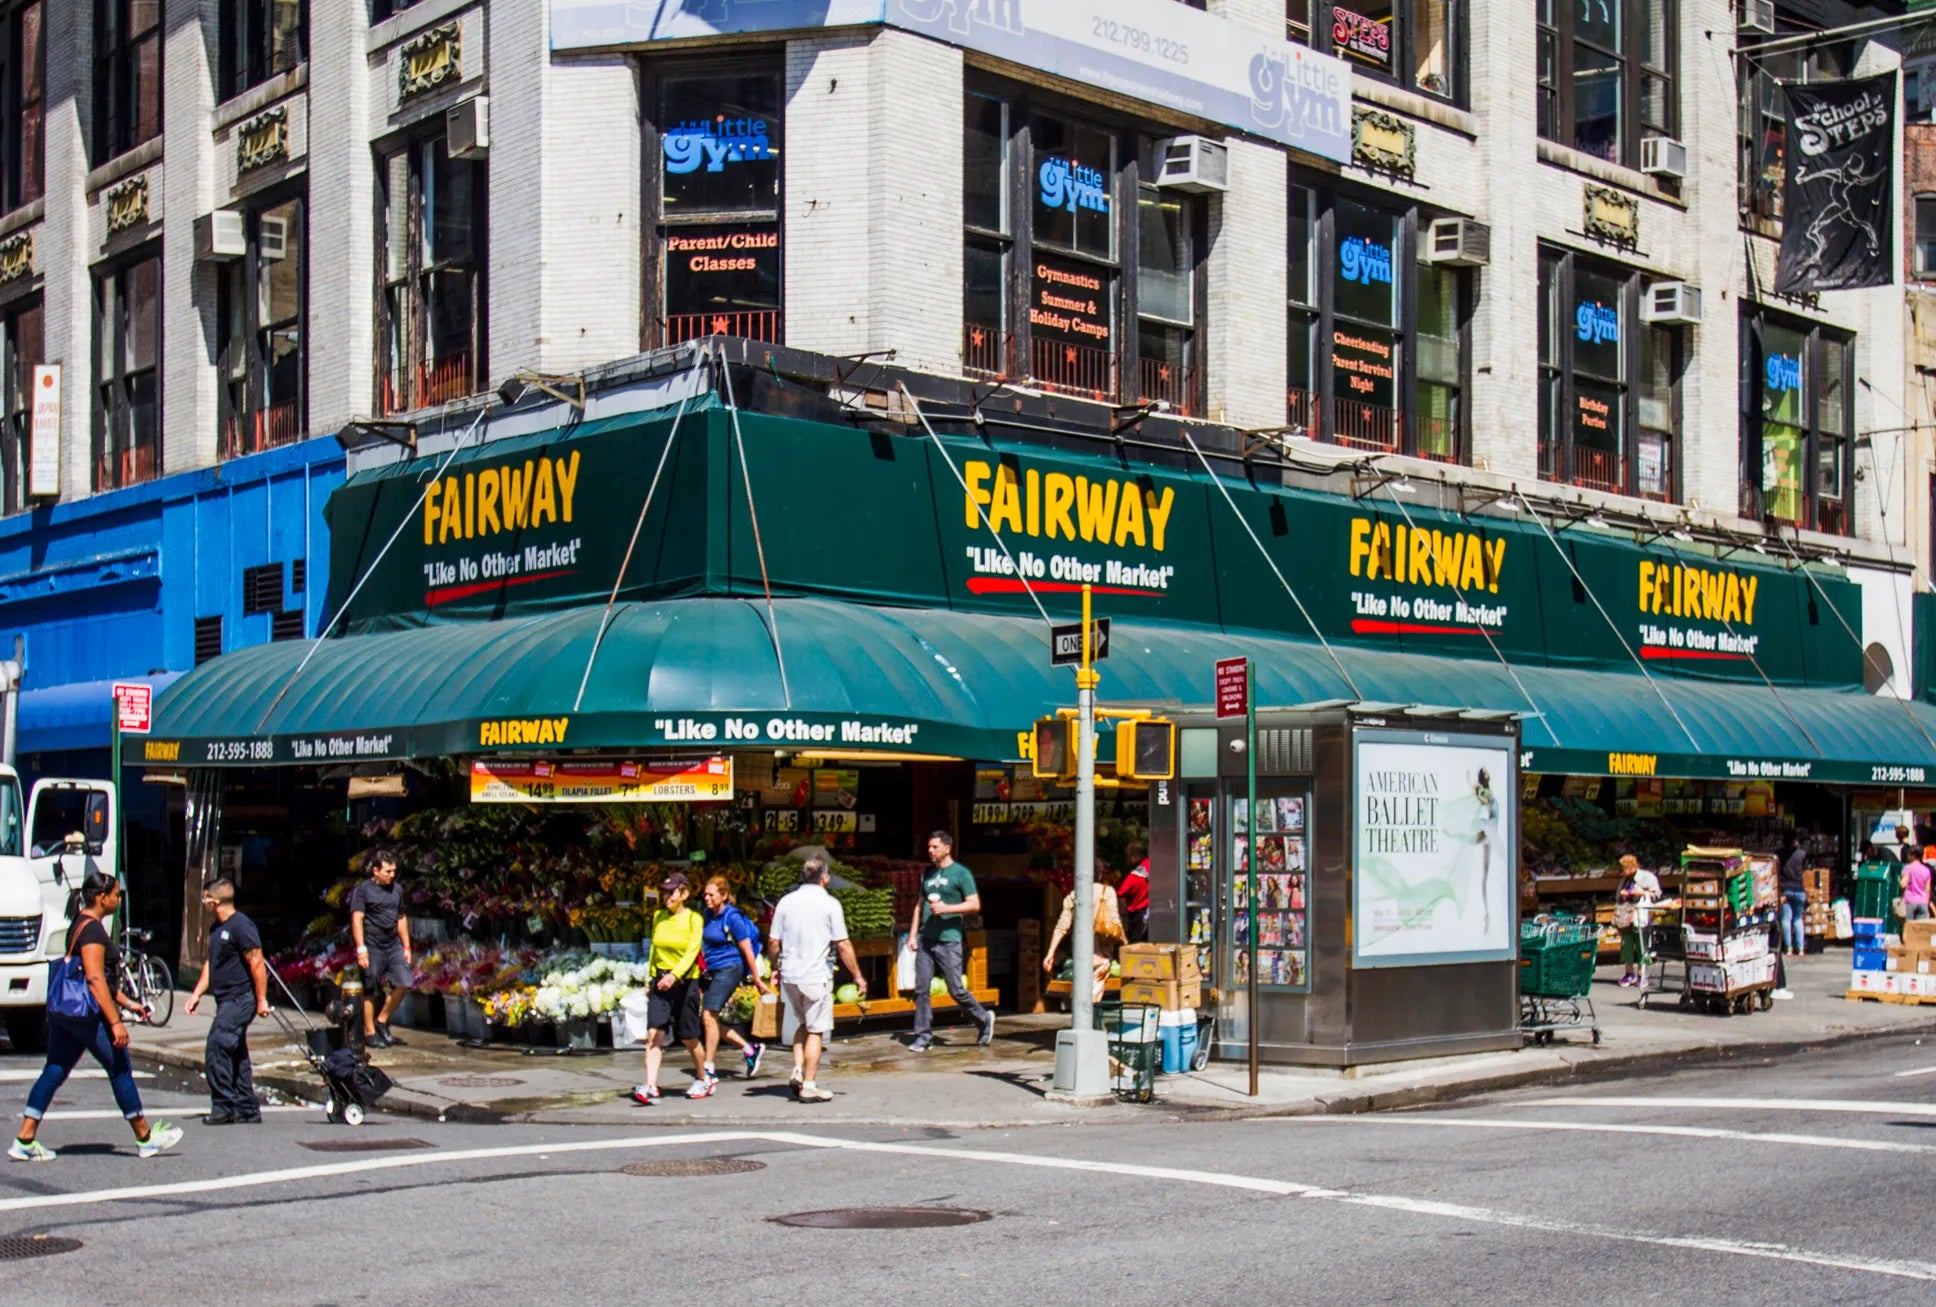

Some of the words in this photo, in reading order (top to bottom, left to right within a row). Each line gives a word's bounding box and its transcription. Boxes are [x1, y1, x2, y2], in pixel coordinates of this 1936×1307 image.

[1092, 16, 1188, 64] 212.799.1225
[1333, 6, 1389, 50] STEPS
[1286, 51, 1338, 95] Little
[1249, 53, 1343, 138] gym
[703, 115, 767, 138] Little
[663, 127, 770, 174] gym
[1066, 160, 1103, 188] Little
[1039, 162, 1108, 213] gym
[668, 233, 778, 251] Parent/Child
[1360, 237, 1390, 262] Little
[690, 256, 756, 272] Classes
[1340, 240, 1392, 285] gym
[1037, 264, 1100, 290] Gymnastics
[1041, 291, 1085, 313] Summer
[1087, 301, 1096, 315] &
[1030, 308, 1070, 332] Holiday
[1072, 318, 1108, 338] Camps
[1577, 302, 1618, 344] gym
[1333, 332, 1389, 358] Cheerleading
[1332, 354, 1357, 371] Parent
[1359, 359, 1392, 379] Survival
[1350, 376, 1374, 394] Night
[1579, 396, 1609, 416] Birthday
[1582, 414, 1607, 429] Parties
[424, 449, 581, 545] FAIRWAY
[965, 460, 1175, 551] FAIRWAY
[424, 559, 456, 586] "Like
[459, 558, 478, 582] No
[481, 552, 521, 578] Other
[525, 538, 581, 571] Market"
[966, 546, 1014, 575] "Like
[1019, 551, 1045, 578] No
[1050, 555, 1101, 582] Other
[1106, 561, 1174, 588] Market"
[1350, 518, 1506, 593] FAIRWAY
[1639, 561, 1757, 625] FAIRWAY
[1351, 592, 1387, 616] "Like
[1390, 596, 1410, 618] No
[1413, 598, 1452, 621] Other
[1456, 601, 1507, 626] Market"
[1639, 624, 1667, 645] "Like
[1669, 626, 1684, 647] No
[1686, 629, 1716, 649] Other
[1718, 632, 1758, 653] Market"
[480, 717, 568, 746] FAIRWAY
[655, 719, 717, 740] "Like
[725, 719, 759, 739] No
[766, 719, 835, 740] Other
[841, 721, 918, 743] Market"
[145, 741, 180, 761] FAIRWAY
[207, 741, 273, 760] 212-595-1888
[292, 740, 312, 758] "Like
[314, 739, 326, 756] No
[329, 737, 354, 756] Other
[356, 735, 392, 755] Market"
[1609, 753, 1657, 776] FAIRWAY
[1727, 760, 1747, 775] "Like
[1748, 762, 1759, 775] No
[1760, 762, 1782, 776] Other
[1782, 762, 1811, 777] Market"
[1872, 766, 1924, 782] 212-595-1888
[562, 787, 588, 796] TILAPIA
[590, 787, 612, 796] FILLET
[653, 785, 696, 796] LOBSTERS
[1366, 771, 1438, 793] AMERICAN
[1367, 796, 1439, 826] BALLET
[1366, 828, 1439, 853] THEATRE
